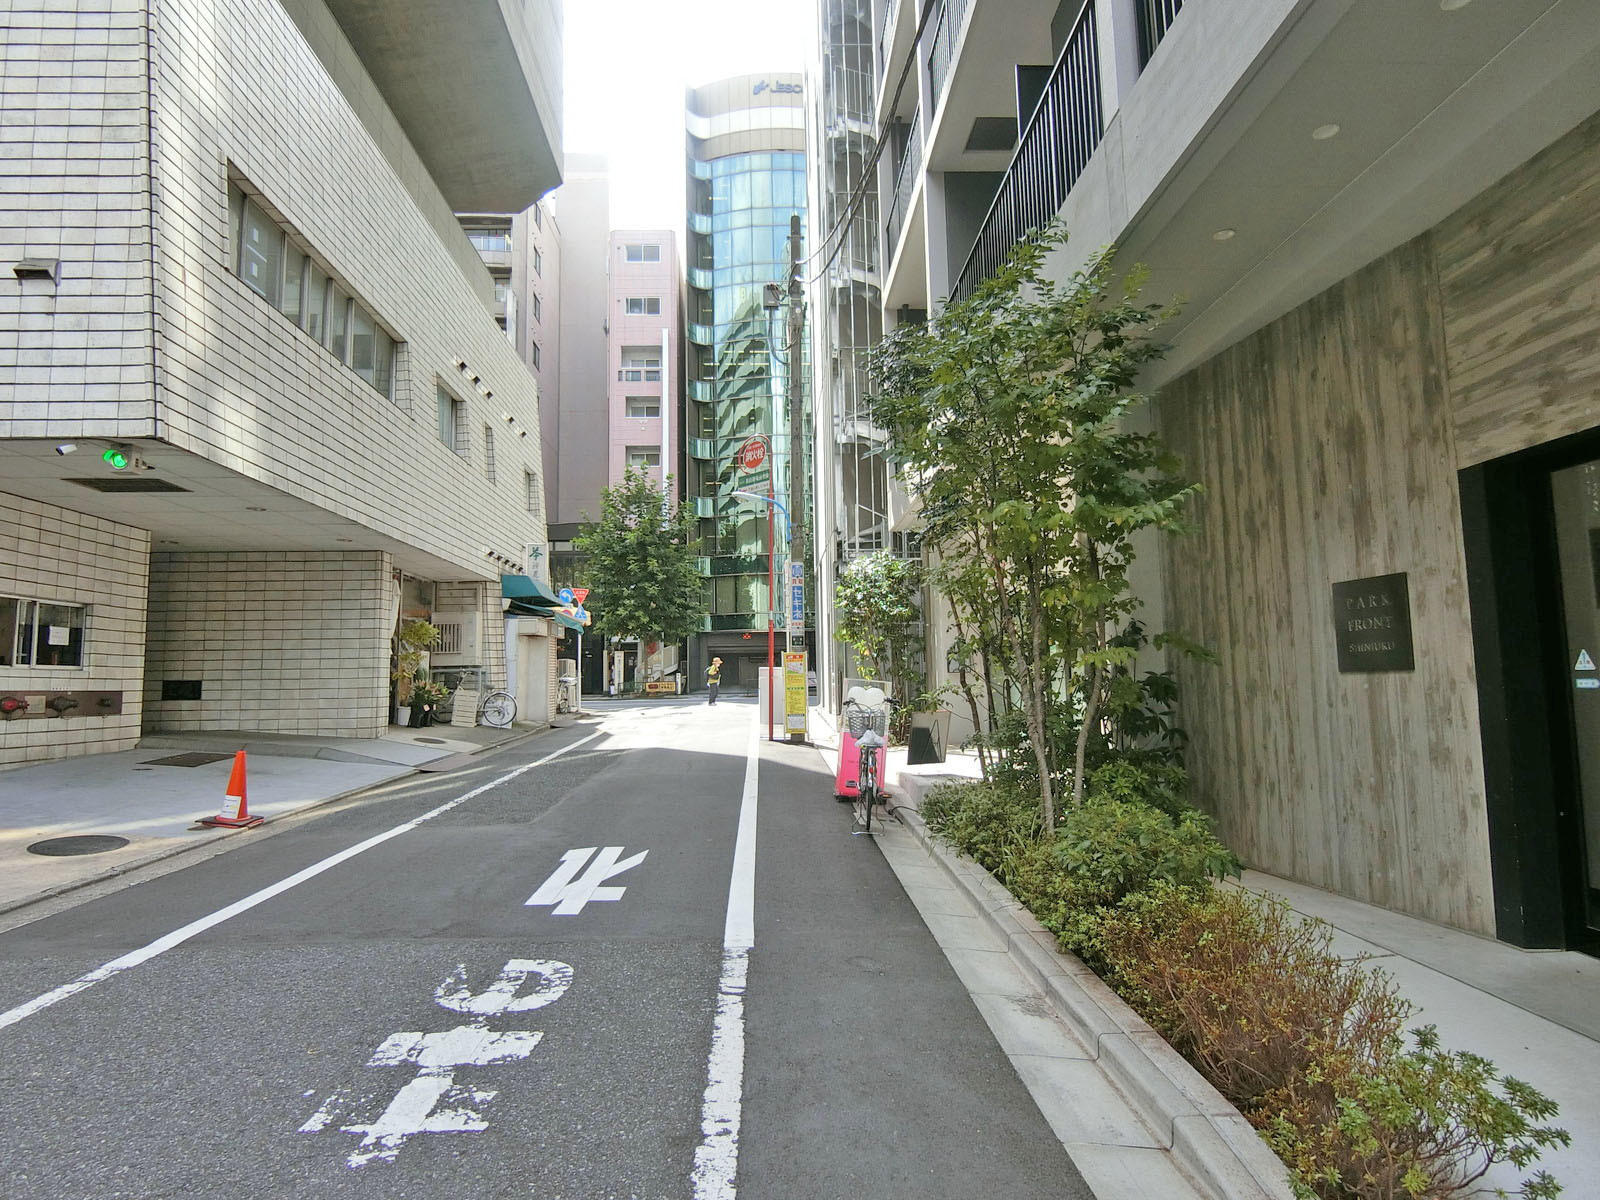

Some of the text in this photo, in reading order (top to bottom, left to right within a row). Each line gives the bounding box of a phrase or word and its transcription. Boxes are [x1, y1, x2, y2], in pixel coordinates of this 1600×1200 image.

[746, 448, 764, 462] 消火栓
[793, 588, 803, 619] セキネ
[1345, 594, 1390, 609] PARK
[1347, 616, 1392, 632] FRONT
